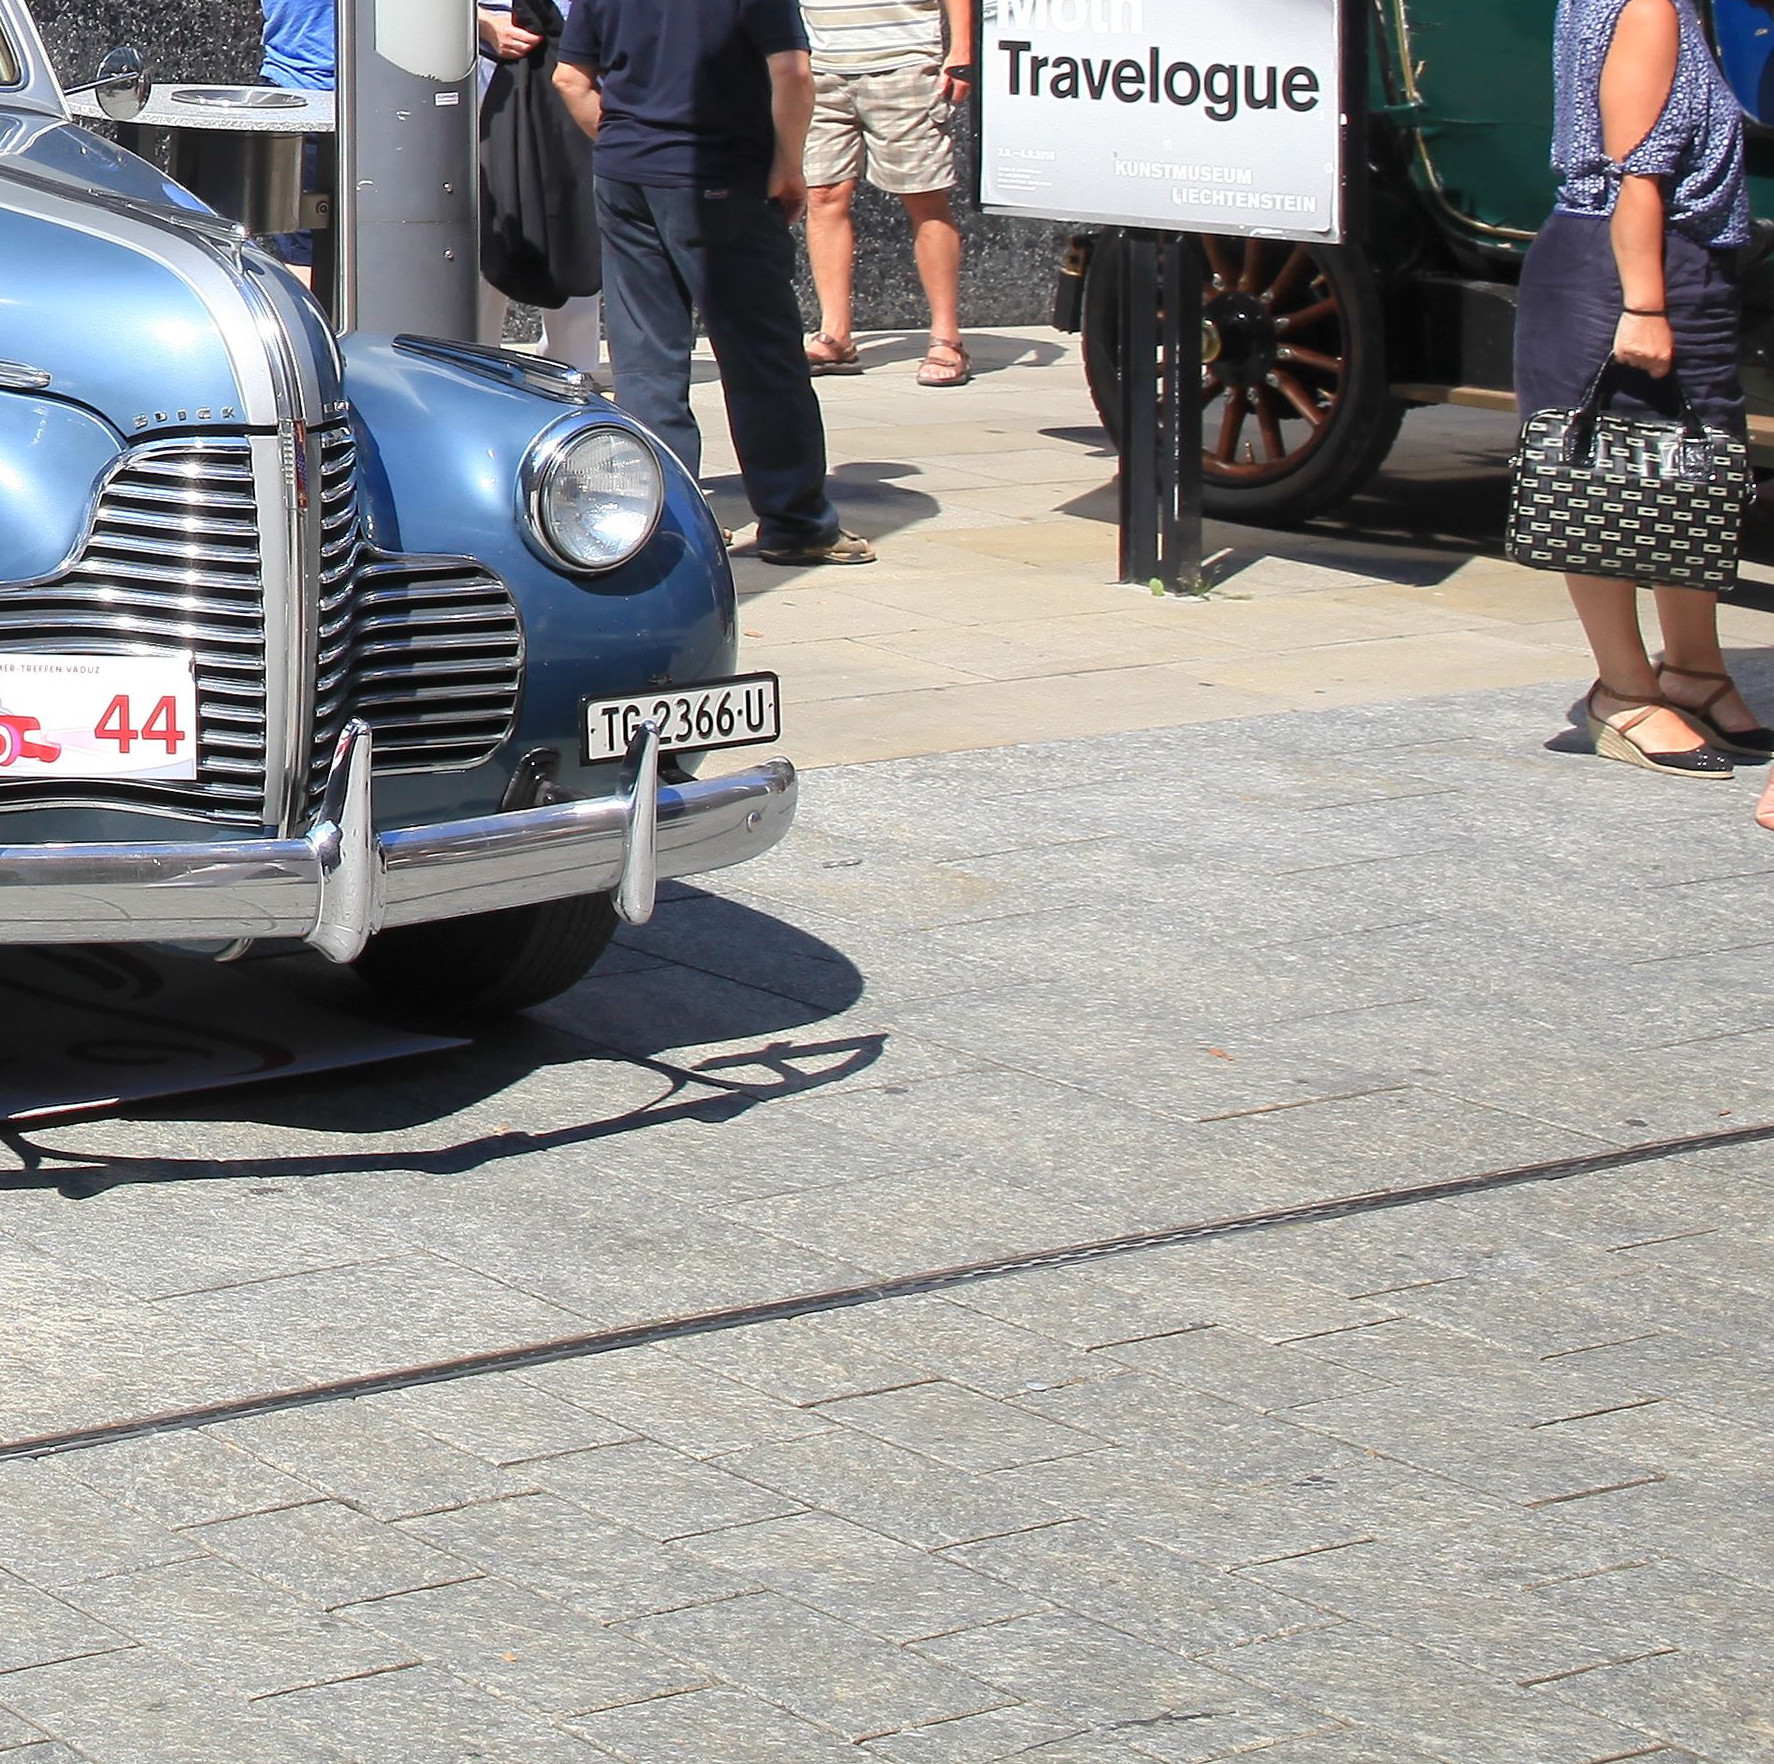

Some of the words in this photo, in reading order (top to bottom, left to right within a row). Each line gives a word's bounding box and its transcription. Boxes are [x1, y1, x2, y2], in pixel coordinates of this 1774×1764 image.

[997, 39, 1321, 123] Travelogue
[1114, 160, 1254, 186] KUNSTMUSEUM
[1172, 186, 1317, 213] LIECHTENSTEIN
[132, 405, 236, 430] BUICK
[66, 665, 101, 675] VADUZ
[94, 694, 186, 755] 44
